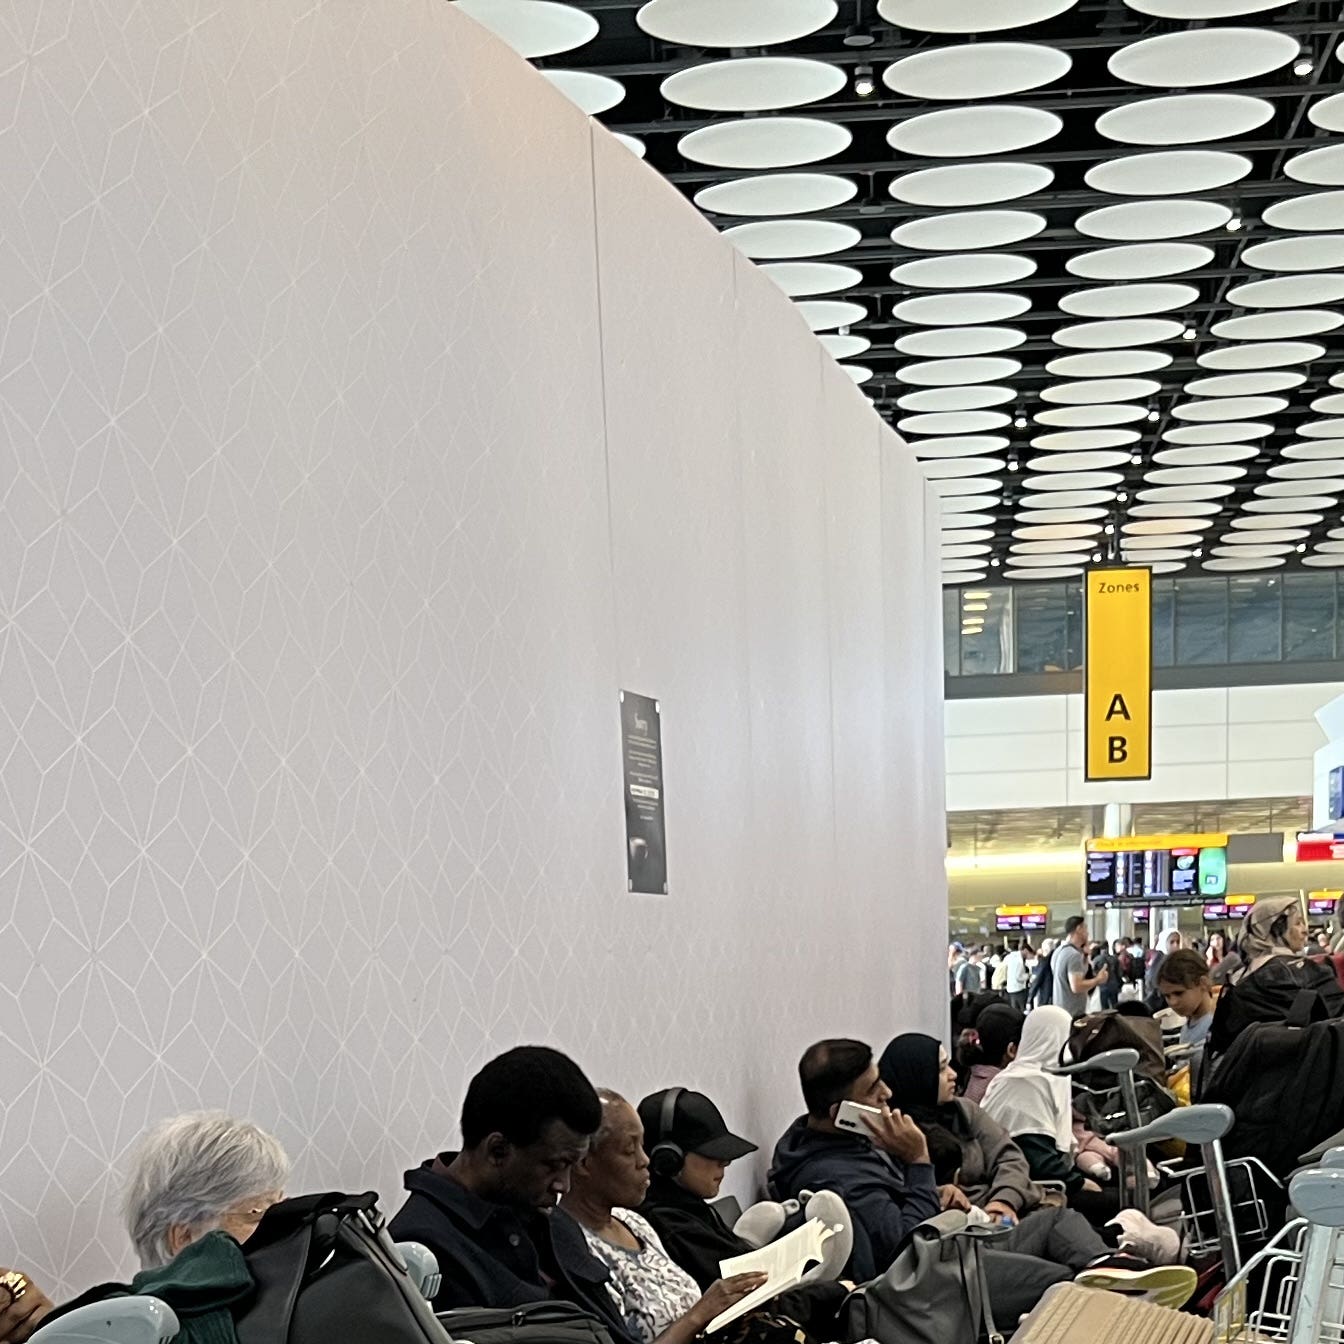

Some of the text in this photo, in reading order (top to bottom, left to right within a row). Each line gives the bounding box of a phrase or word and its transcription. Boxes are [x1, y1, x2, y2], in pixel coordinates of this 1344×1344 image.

[1098, 582, 1140, 594] Zones
[1105, 693, 1131, 722] A
[1108, 736, 1128, 764] B
